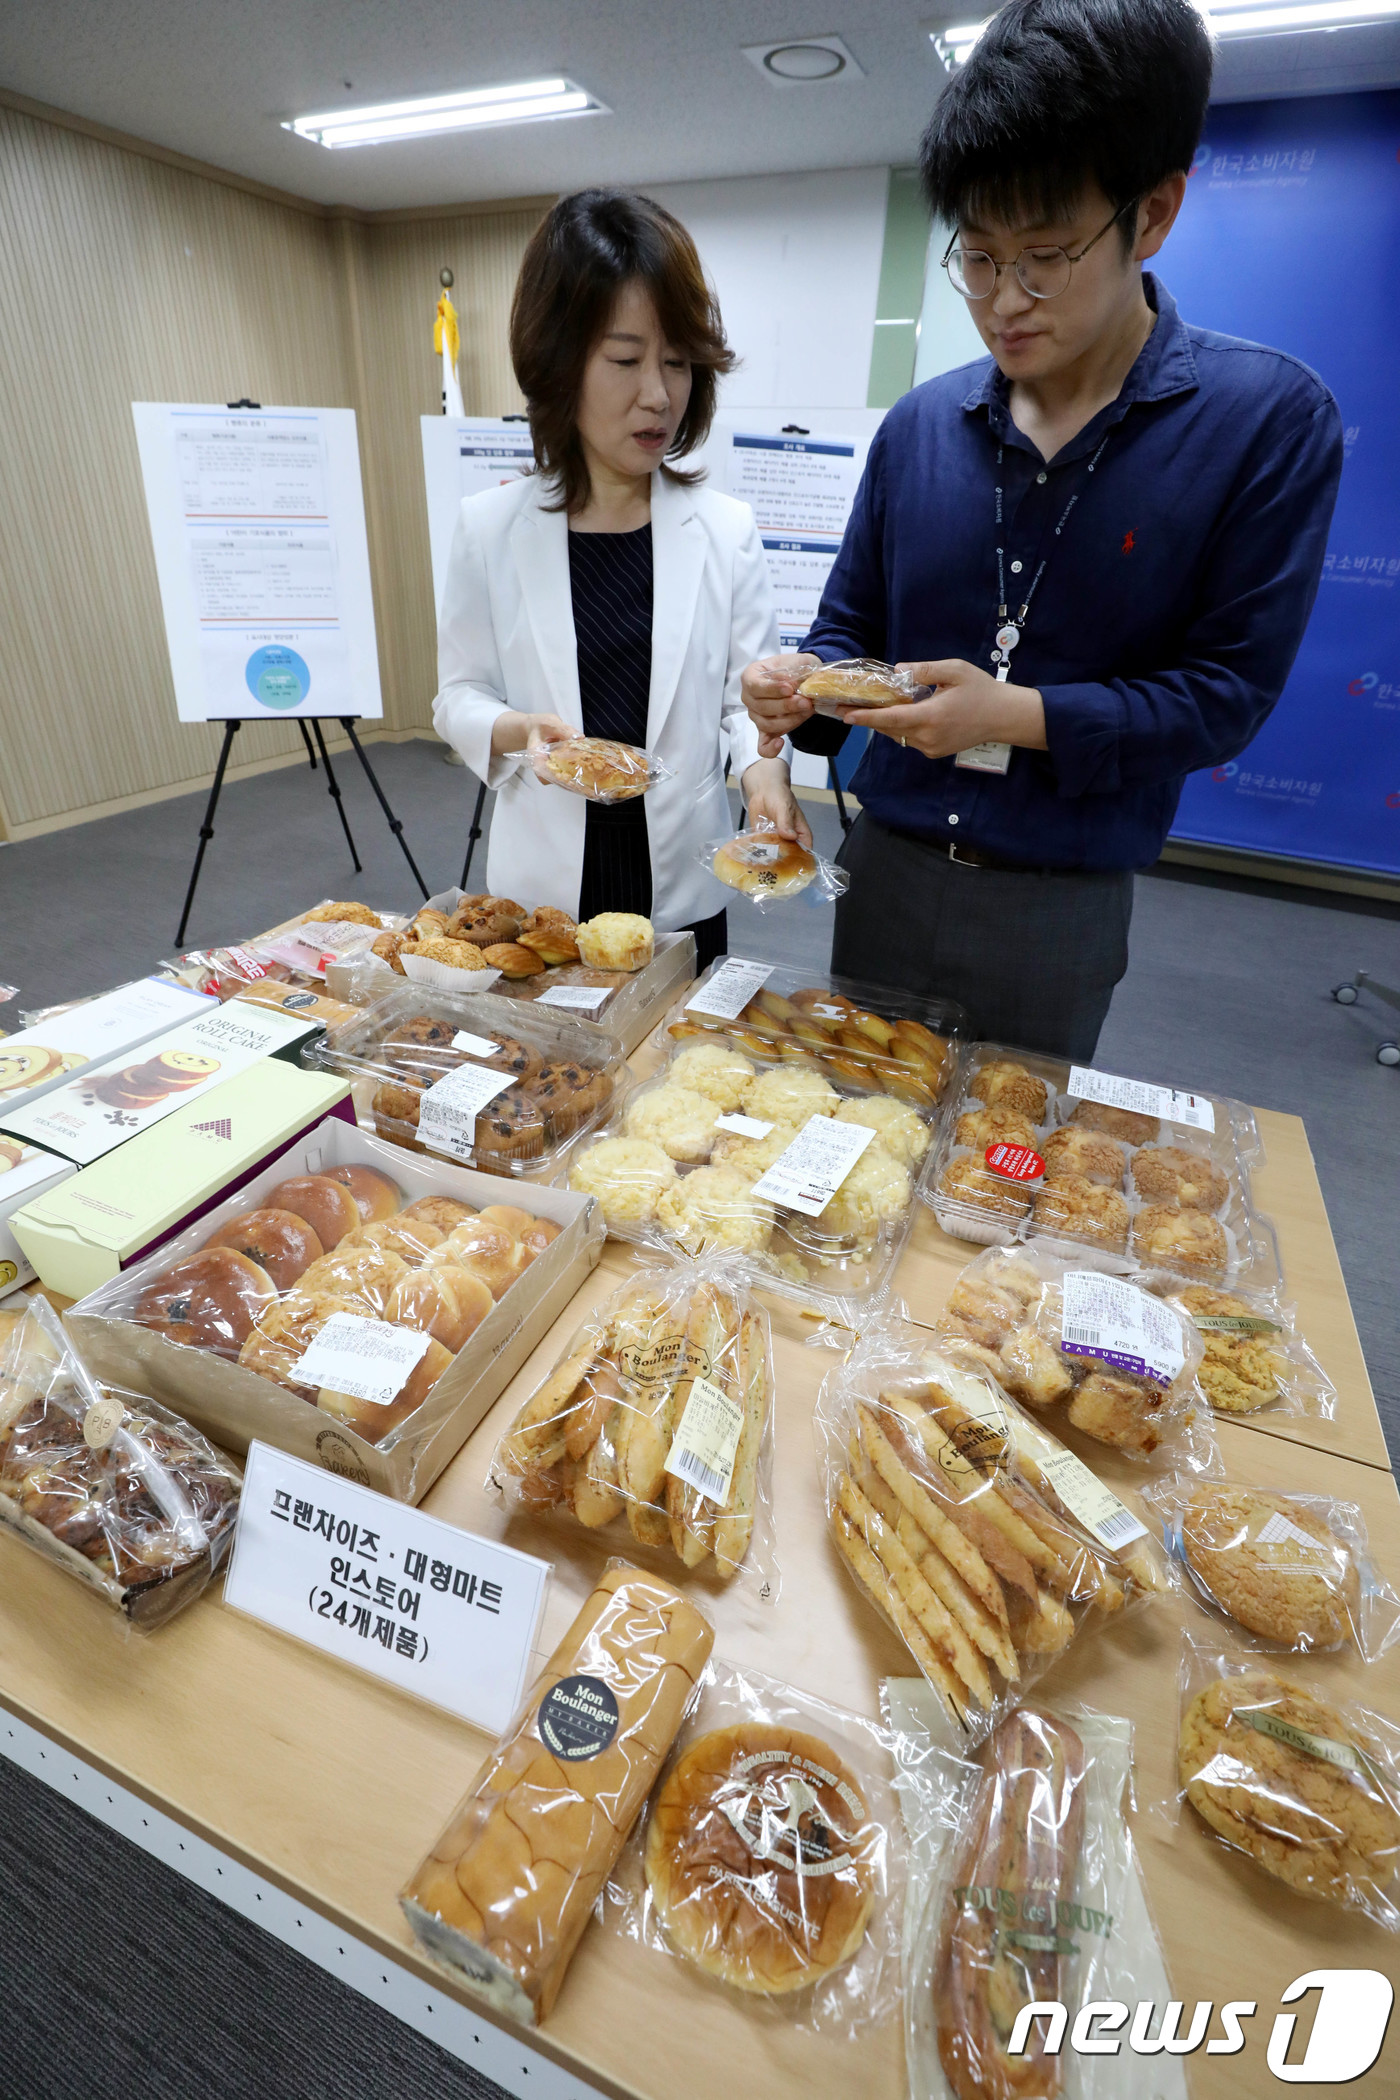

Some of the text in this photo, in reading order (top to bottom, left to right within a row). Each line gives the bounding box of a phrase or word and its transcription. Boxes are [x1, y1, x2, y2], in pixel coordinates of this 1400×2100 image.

[1212, 148, 1317, 177] 한국소비자원
[1324, 554, 1400, 576] 국소비자원
[1238, 772, 1323, 796] 한국소비자원
[192, 1022, 270, 1051] ROLL CAKE
[208, 1017, 272, 1043] ORIGINAL
[196, 1038, 229, 1053] ORIGINAL
[33, 1117, 51, 1128] TOUS
[56, 1126, 80, 1139] JOURS
[1203, 1319, 1229, 1327] TOUS
[654, 1341, 681, 1356] Mon
[1113, 1340, 1139, 1352] 4720 원
[632, 1351, 701, 1367] Boulanger
[1153, 1360, 1170, 1370] 5900
[700, 1383, 741, 1422] Mon Boulanger
[961, 1421, 993, 1439] Mon
[1042, 1454, 1076, 1470] Mon Boulanger
[269, 1488, 381, 1562] 프랜차이즈
[403, 1547, 503, 1615] 대형마트
[330, 1556, 421, 1621] 인스토어
[308, 1585, 429, 1664] (24개제품)
[552, 1687, 618, 1725] Boulanger
[575, 1684, 604, 1706] Mon
[1264, 1720, 1306, 1748] TOUS
[739, 1750, 865, 1820] HEALTHY & FRESH BREAD
[708, 1864, 822, 1941] PARIS BAGUETTE
[953, 1886, 1017, 1917] TOUS
[1022, 1895, 1048, 1922] les
